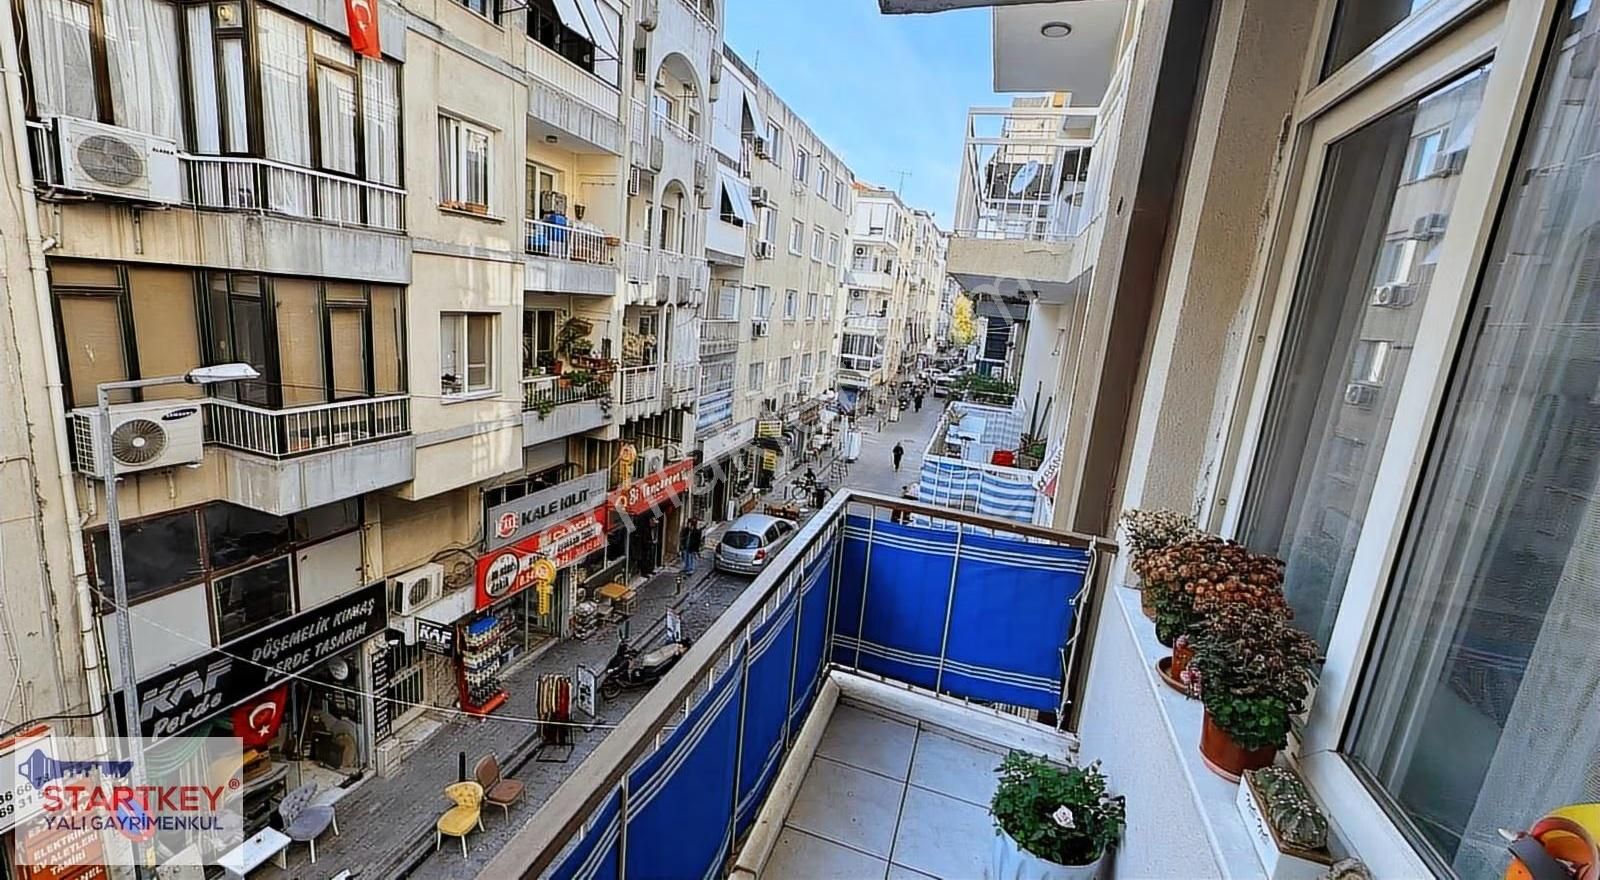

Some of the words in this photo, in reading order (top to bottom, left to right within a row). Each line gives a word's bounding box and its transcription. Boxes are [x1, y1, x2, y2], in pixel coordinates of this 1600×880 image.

[521, 500, 558, 526] KALE
[252, 616, 331, 662] DÖŞEMELİK
[264, 648, 311, 682] PERDE
[315, 621, 367, 657] TASARIM
[420, 624, 452, 645] KAF
[140, 656, 233, 723] KAF
[152, 692, 222, 742] Perde
[33, 859, 48, 874] EV
[50, 849, 86, 875] TAMİRİ
